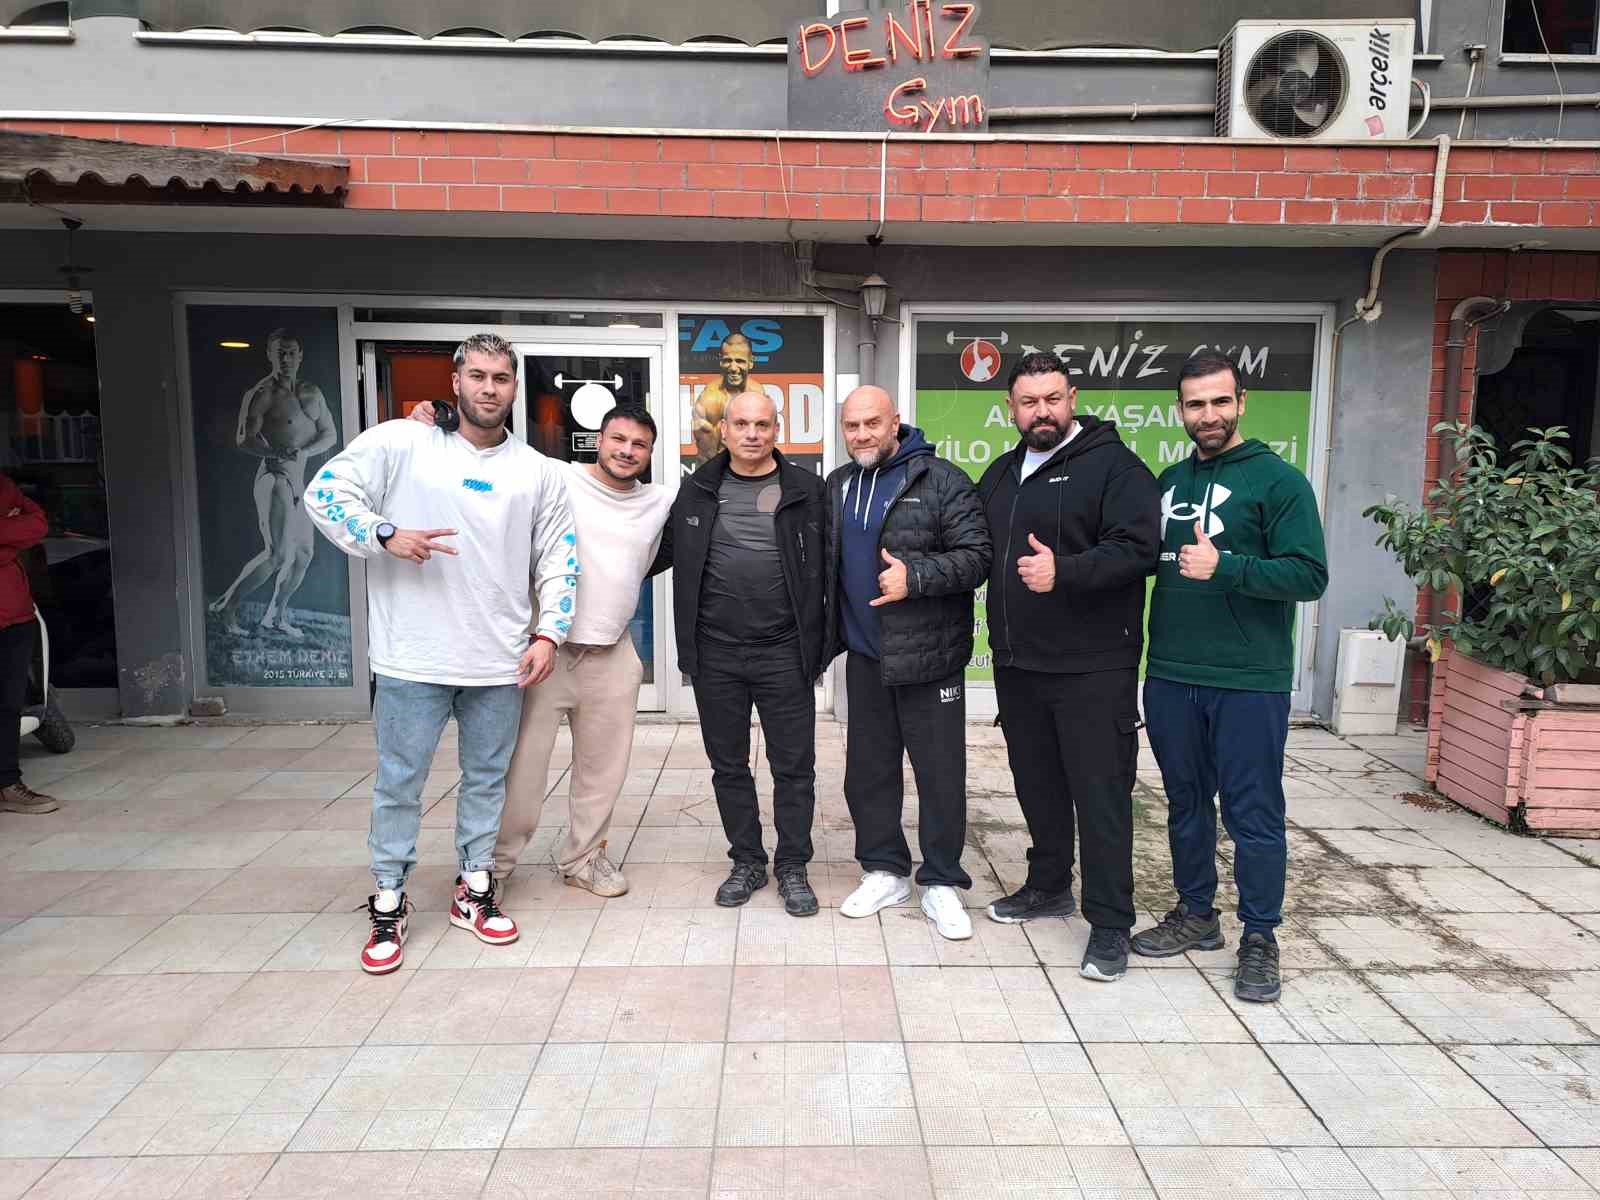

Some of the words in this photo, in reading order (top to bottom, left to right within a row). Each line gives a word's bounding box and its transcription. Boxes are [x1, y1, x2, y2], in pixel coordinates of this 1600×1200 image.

[1368, 28, 1391, 111] arçelik
[886, 77, 983, 133] Gym
[264, 670, 285, 679] 2015
